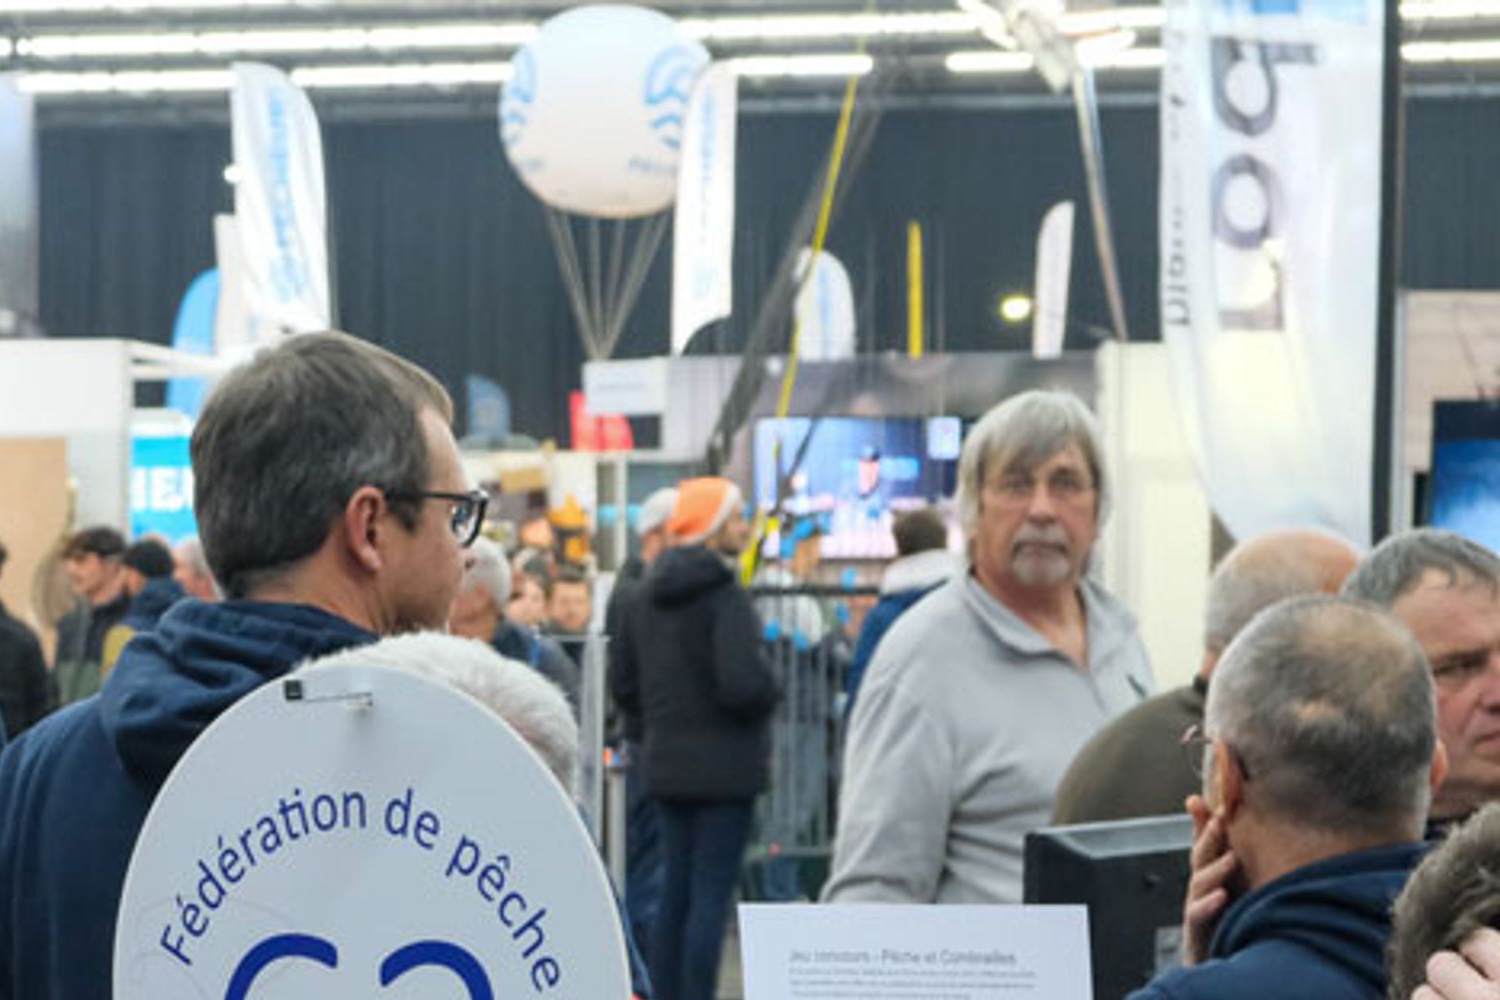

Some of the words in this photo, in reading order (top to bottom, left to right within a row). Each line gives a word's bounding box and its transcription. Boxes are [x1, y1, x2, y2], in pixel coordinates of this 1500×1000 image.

[160, 788, 367, 967] Fédération
[385, 787, 441, 850] de
[445, 835, 562, 992] pêche
